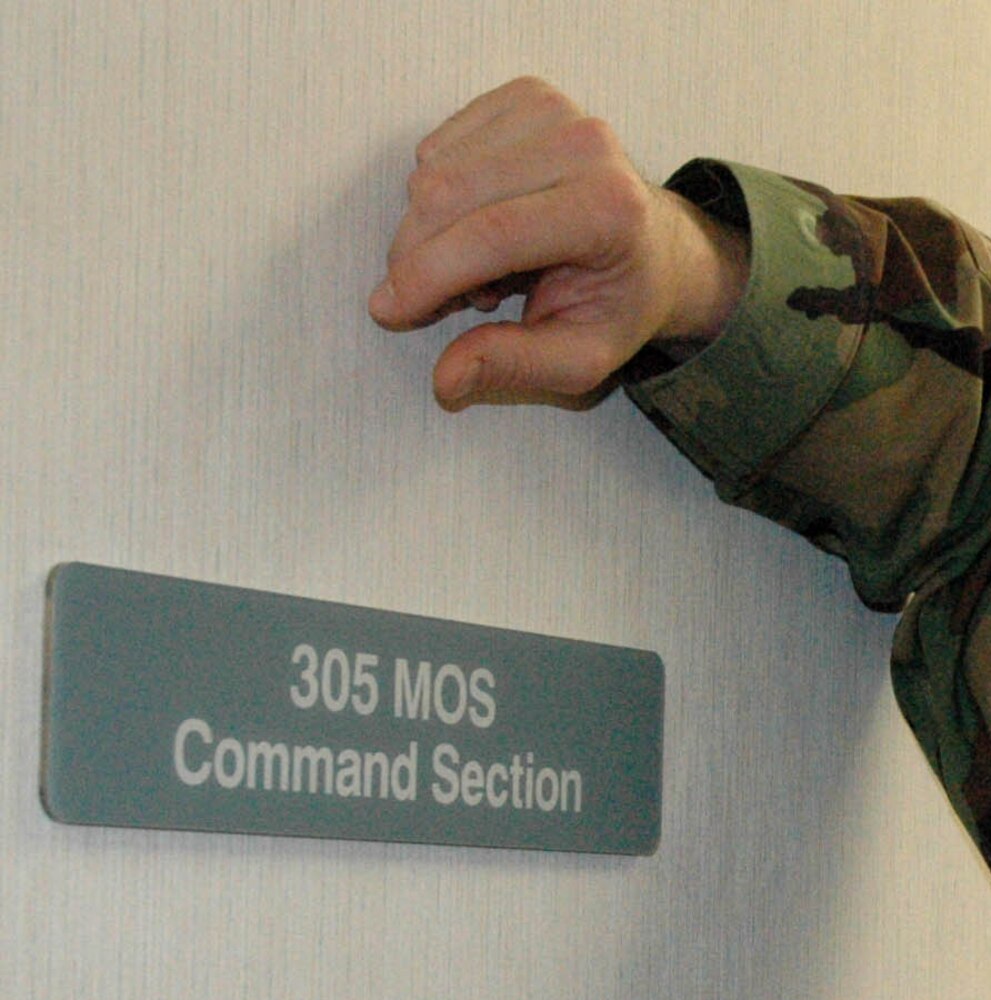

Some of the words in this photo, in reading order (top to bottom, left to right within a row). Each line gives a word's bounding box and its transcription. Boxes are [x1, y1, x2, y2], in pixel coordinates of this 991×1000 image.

[289, 643, 380, 716] 305
[393, 657, 497, 729] MOS
[173, 717, 418, 802] Command
[431, 742, 582, 812] Section
